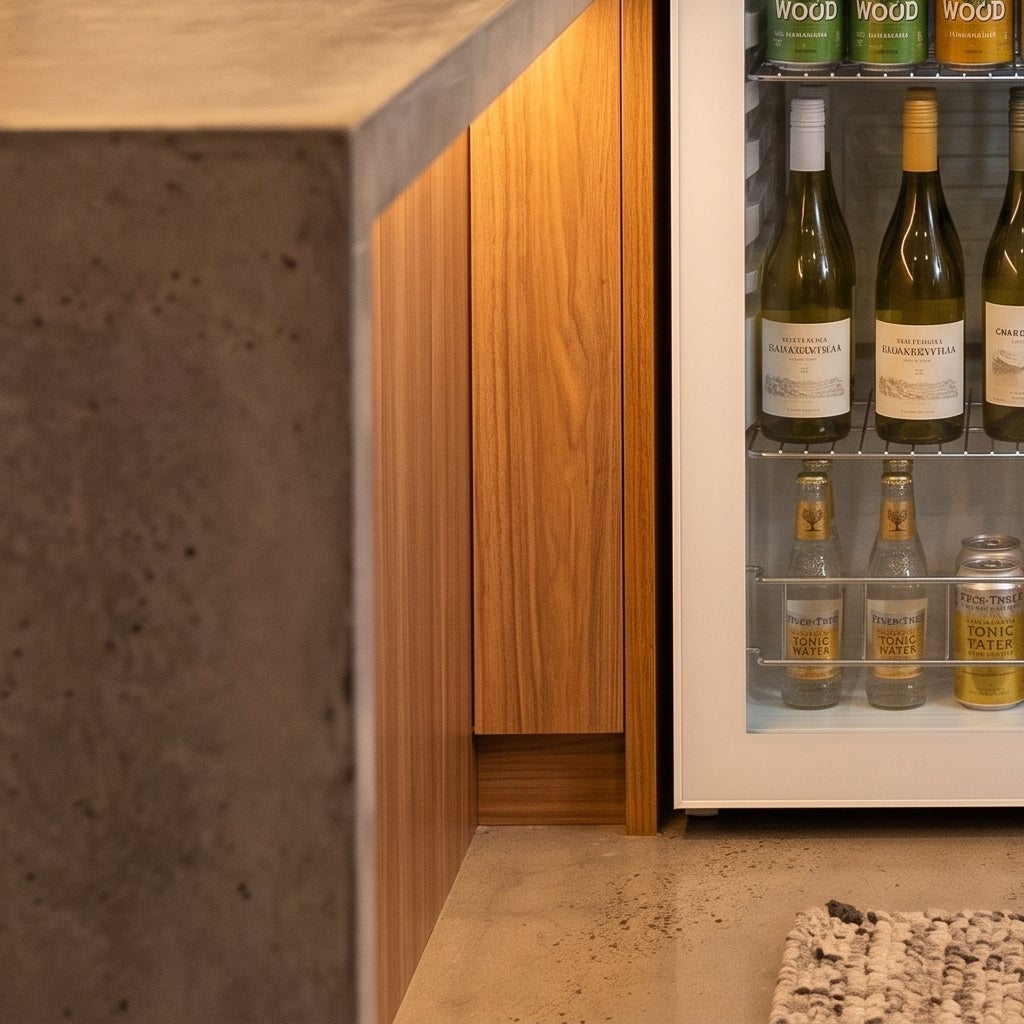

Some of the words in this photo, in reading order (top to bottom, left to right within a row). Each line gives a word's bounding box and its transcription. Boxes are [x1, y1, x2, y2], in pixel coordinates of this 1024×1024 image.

[968, 625, 1014, 638] TONIC
[792, 636, 830, 647] TONIC
[878, 635, 917, 646] TONIC
